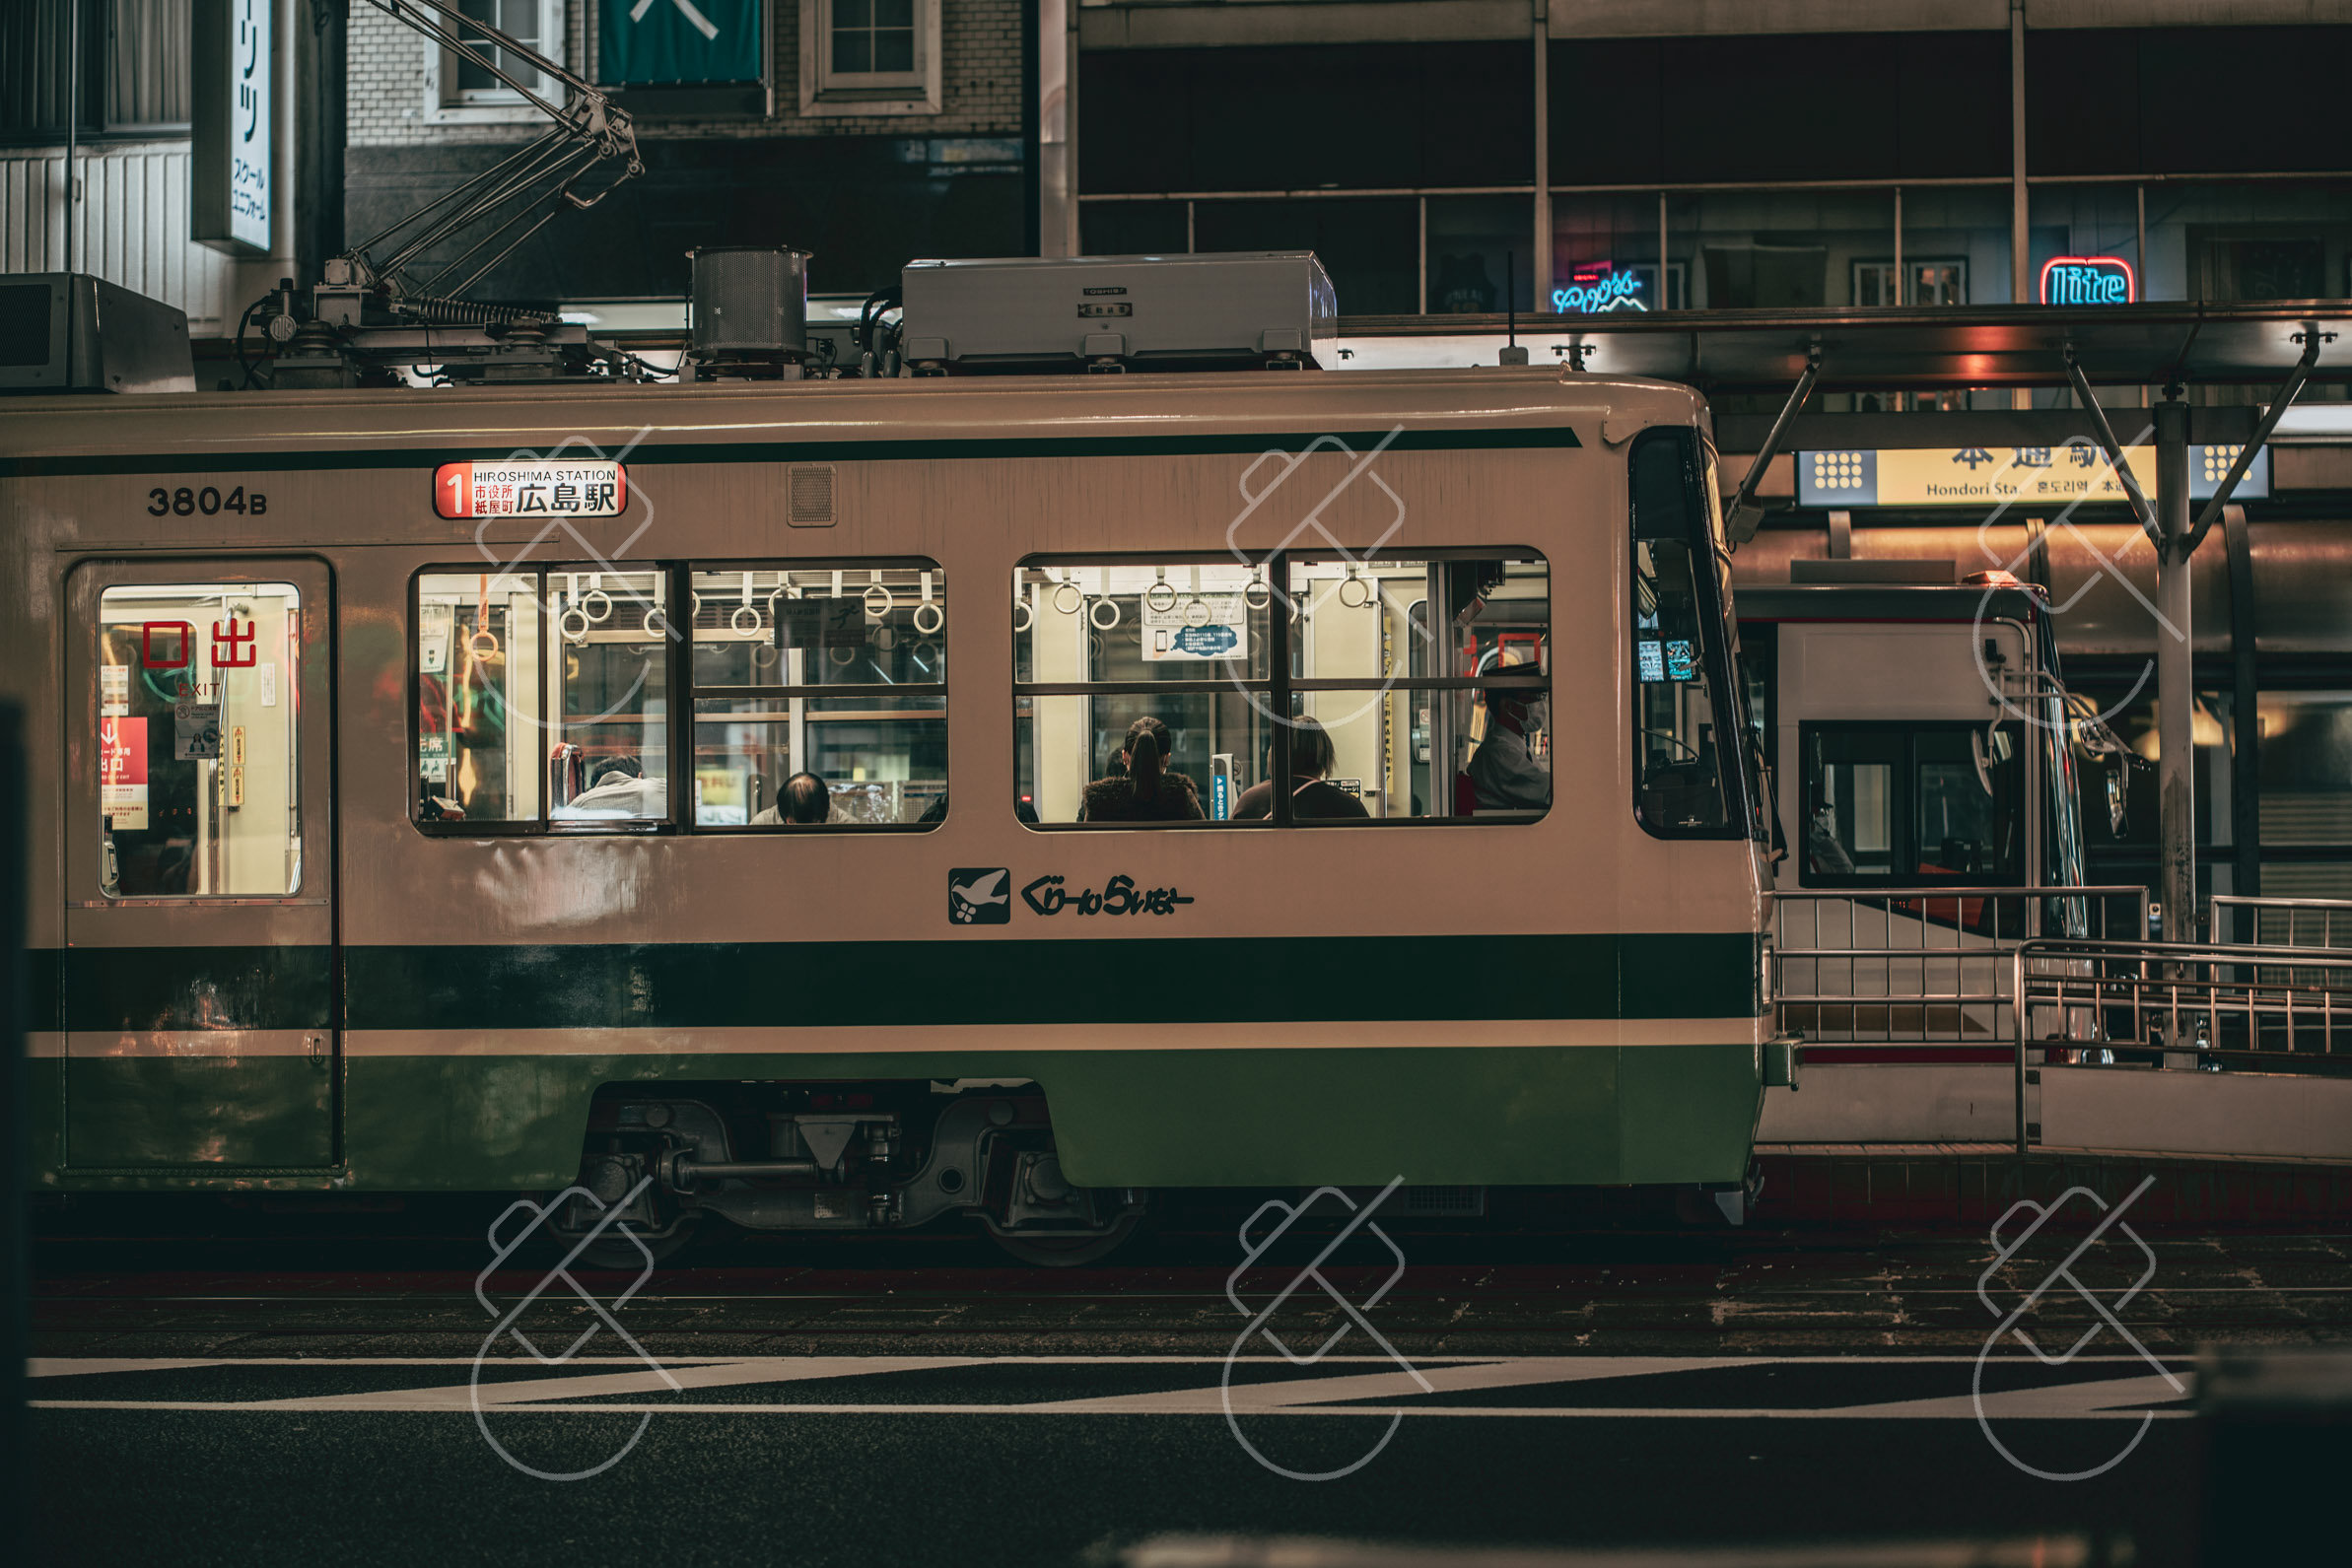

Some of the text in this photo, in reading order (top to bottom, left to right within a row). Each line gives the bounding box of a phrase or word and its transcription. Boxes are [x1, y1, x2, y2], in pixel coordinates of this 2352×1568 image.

[234, 158, 265, 190] スクール
[474, 469, 616, 483] HIROSHIMA STATION
[447, 473, 462, 514] 1
[474, 484, 514, 500] 市役所
[1927, 482, 2022, 497] Hondori Sta.
[147, 486, 267, 516] 3804B
[516, 483, 616, 513] 広島駅
[474, 500, 514, 515] 紙屋町
[178, 683, 220, 697] EXIT
